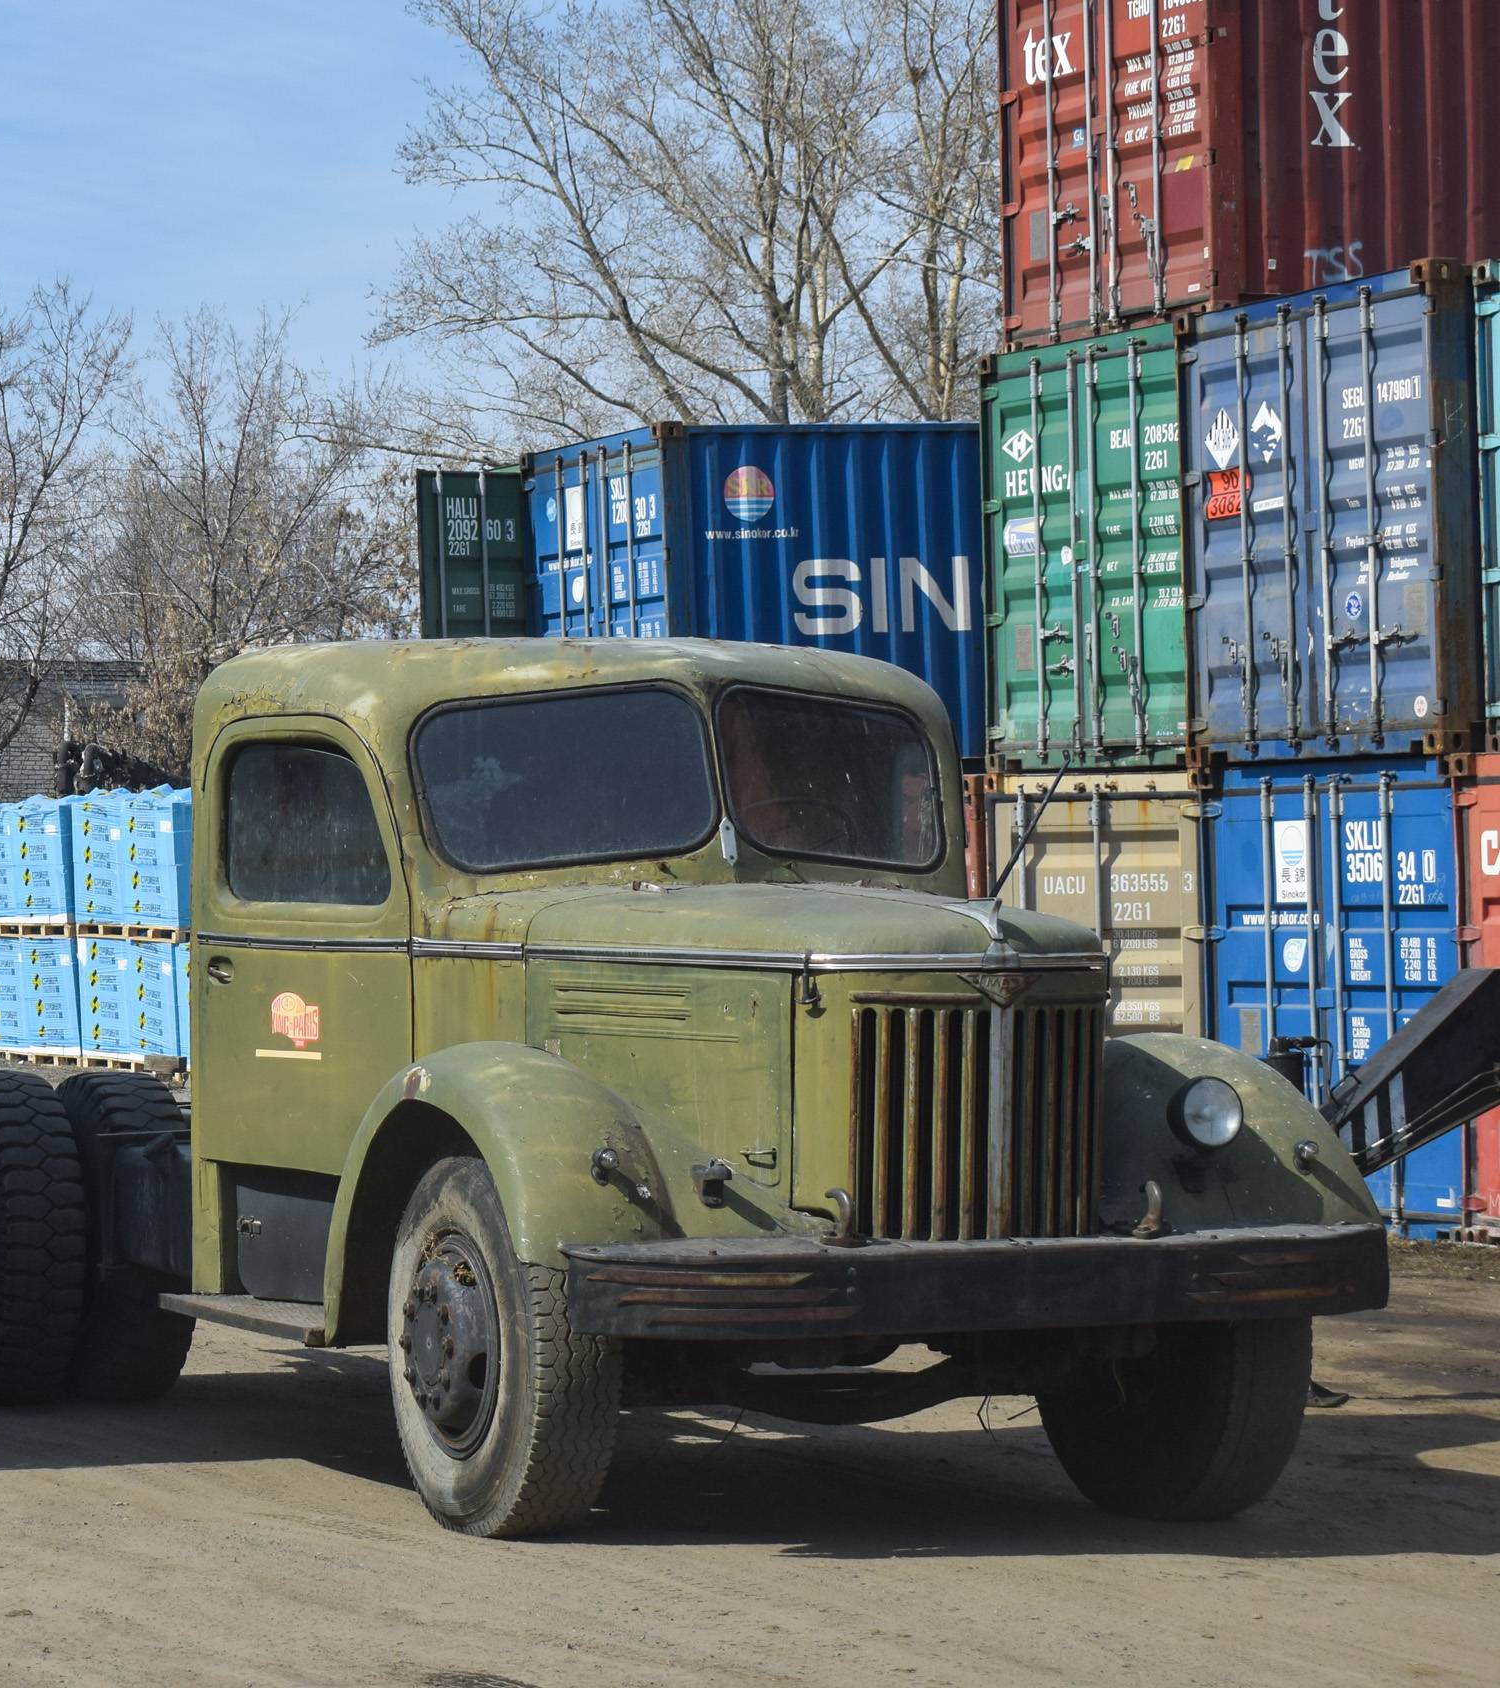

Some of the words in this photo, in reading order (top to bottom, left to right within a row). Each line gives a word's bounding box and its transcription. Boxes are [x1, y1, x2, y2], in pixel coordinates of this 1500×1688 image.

[1162, 13, 1186, 37] 22G1
[1185, 50, 1194, 60] LBS
[1180, 74, 1190, 85] LBS
[1186, 98, 1196, 109] LBS
[1377, 379, 1411, 403] 147960
[1145, 449, 1167, 470] 22G1
[1221, 472, 1239, 492] 90
[446, 497, 478, 518] HALU
[635, 497, 646, 520] 30
[447, 519, 479, 541] 2092
[486, 519, 501, 540] 60
[705, 526, 799, 540] www.sinokor.co.kr
[448, 541, 470, 556] 22G1
[1346, 536, 1365, 549] Payloa
[793, 556, 972, 635] SIN
[1345, 820, 1382, 850] SKLU
[1481, 829, 1500, 876] C
[1346, 852, 1383, 882] 3506
[1397, 851, 1416, 881] 34
[1043, 876, 1086, 895] UACU
[1111, 874, 1169, 892] 363555
[1282, 889, 1306, 899] Sinokor
[1398, 884, 1425, 904] 22G1
[1114, 902, 1151, 921] 22G1
[1143, 929, 1158, 938] KGS
[1143, 939, 1159, 949] LBS
[1119, 966, 1141, 977] 2.130
[1143, 966, 1160, 976] KGS
[1144, 1002, 1160, 1012] KGS
